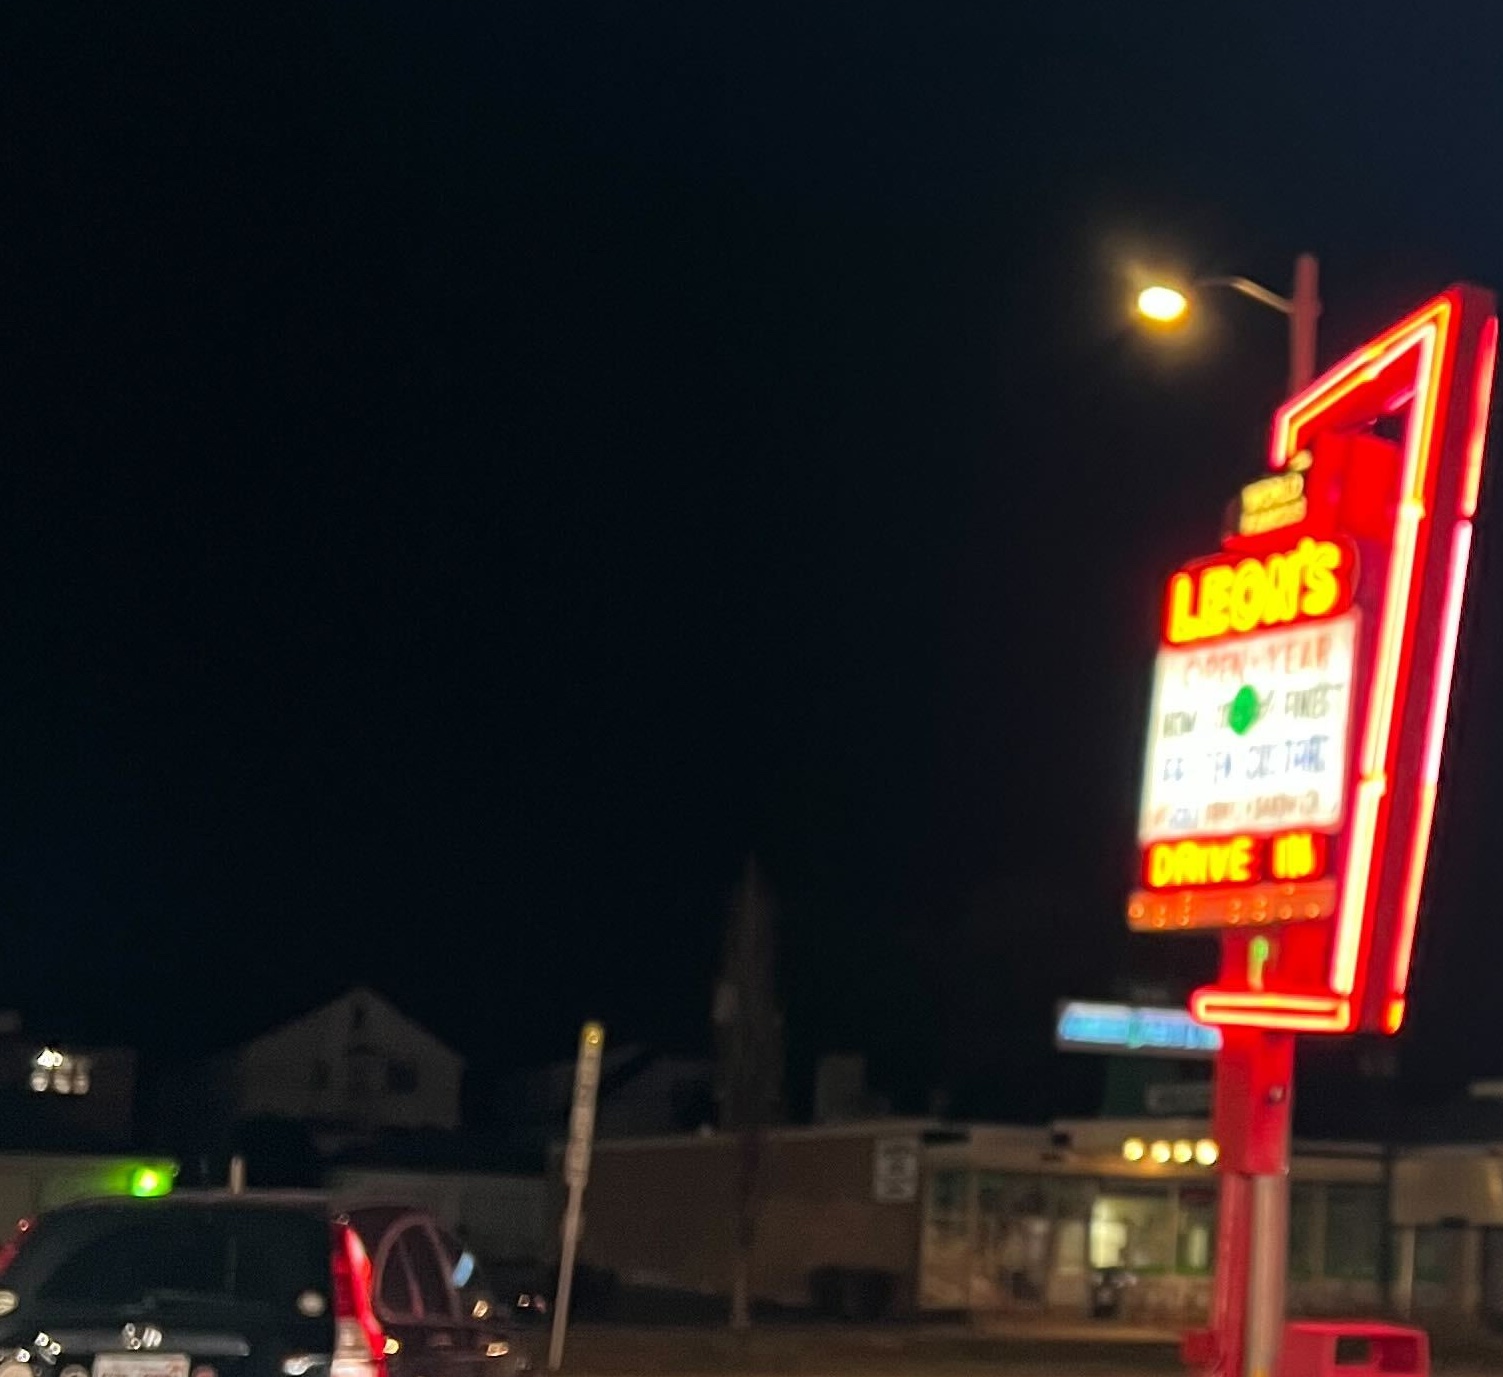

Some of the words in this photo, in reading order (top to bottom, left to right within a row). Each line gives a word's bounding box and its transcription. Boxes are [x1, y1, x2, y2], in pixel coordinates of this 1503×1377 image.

[1168, 536, 1342, 644] LEON'S
[1150, 835, 1252, 888] DRIVE
[1273, 832, 1313, 880] IN
